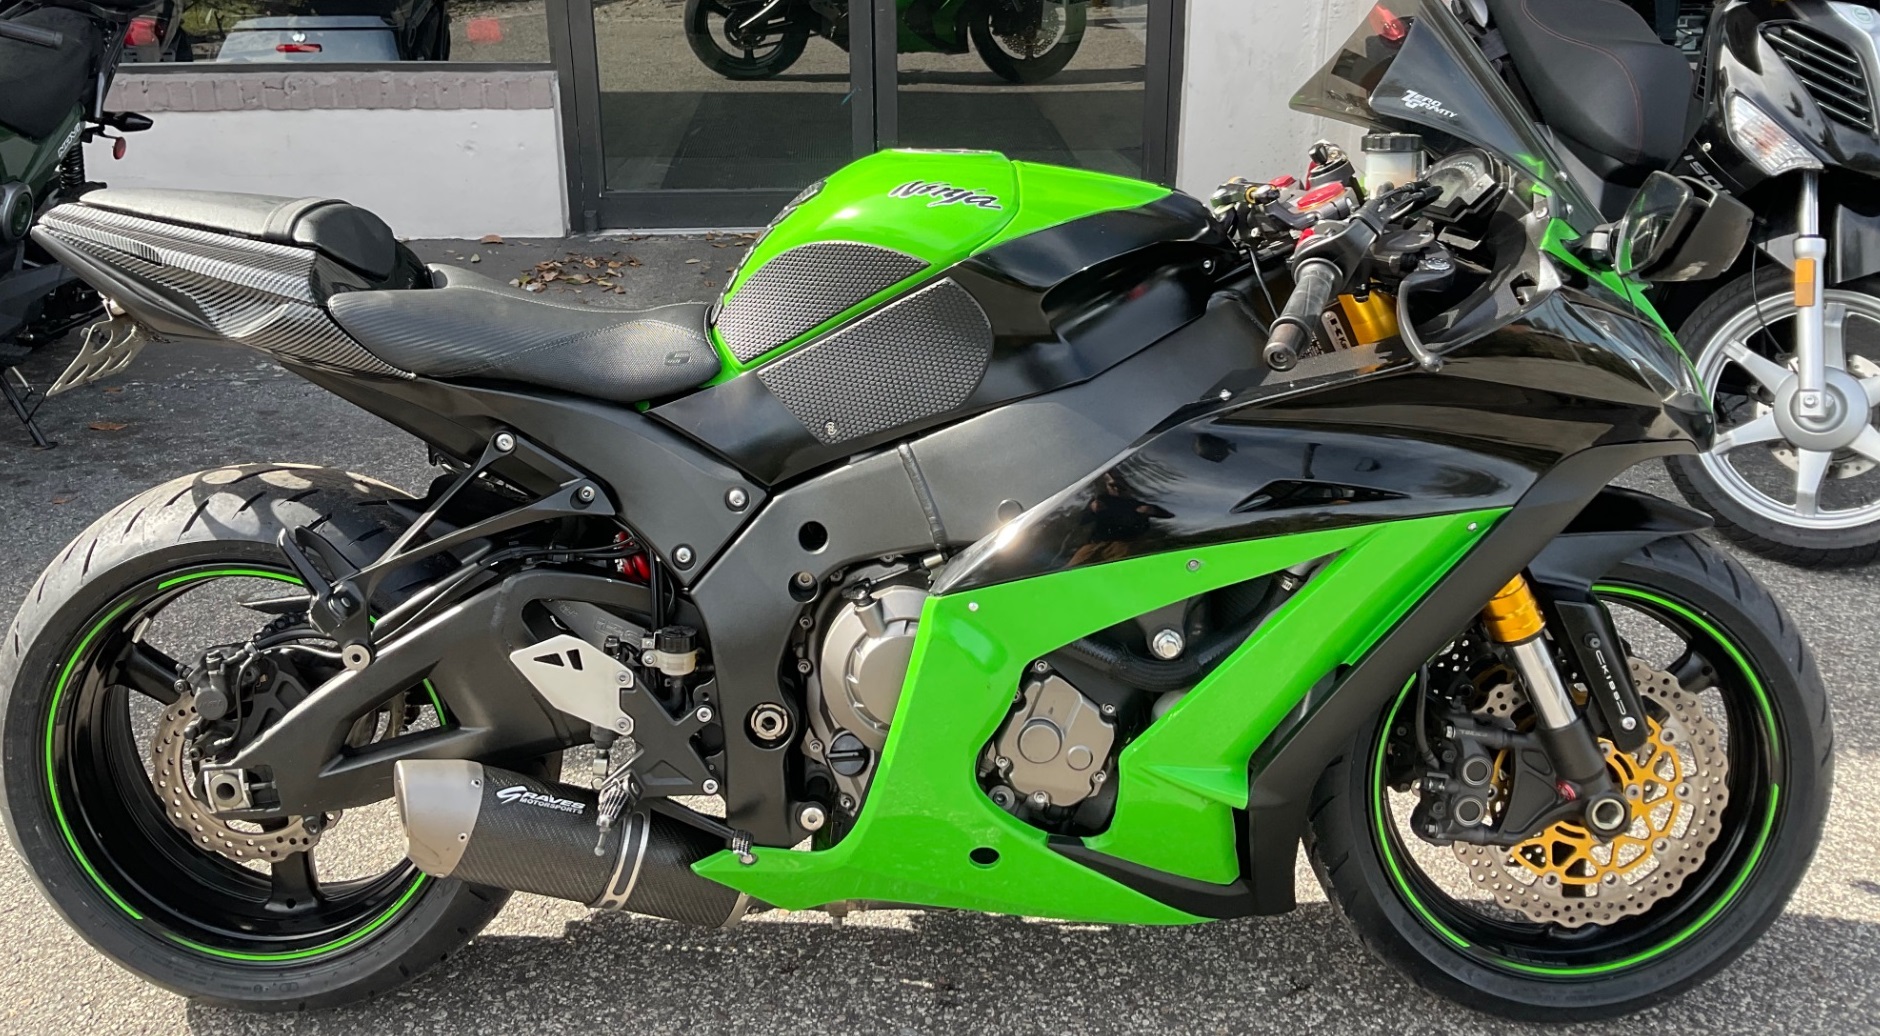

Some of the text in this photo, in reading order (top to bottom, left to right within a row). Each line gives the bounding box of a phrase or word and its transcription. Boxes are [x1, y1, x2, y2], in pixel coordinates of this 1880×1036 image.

[1401, 89, 1442, 107] ZERO
[1404, 100, 1458, 118] GRAVITY
[887, 179, 1004, 211] Ninja
[496, 785, 586, 810] GRAVES
[519, 797, 584, 815] MOTORSPORTS
